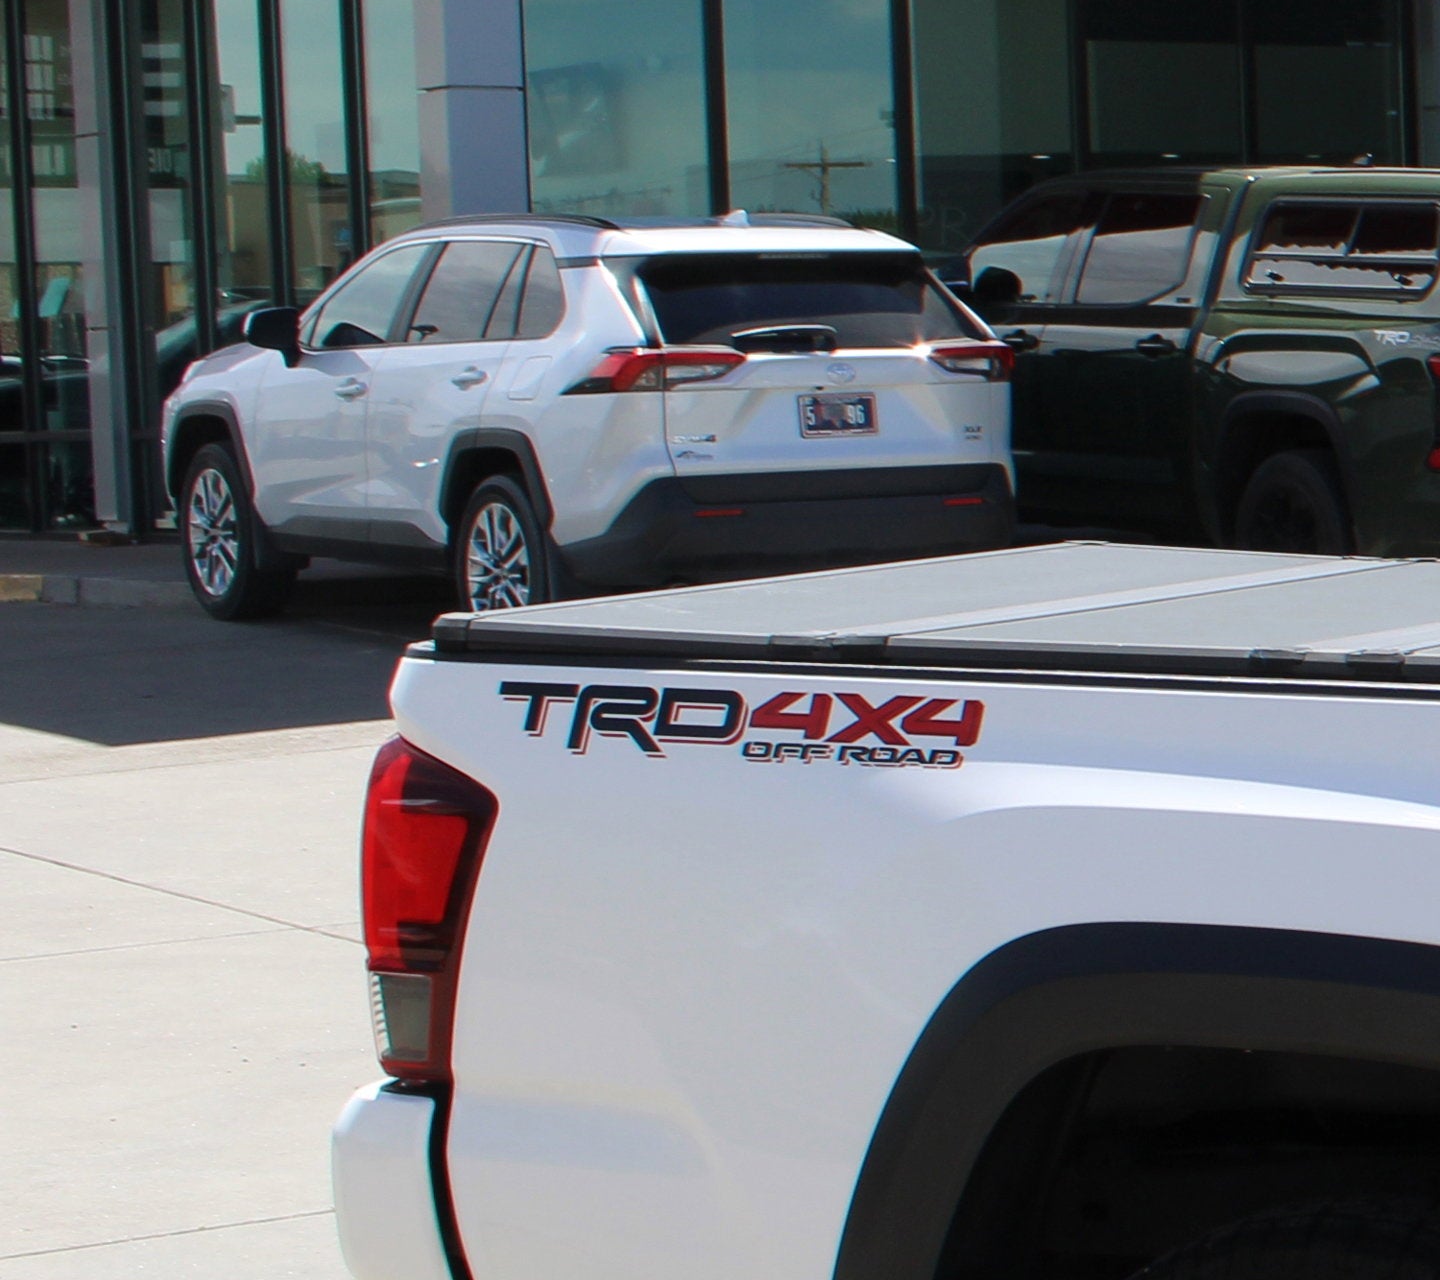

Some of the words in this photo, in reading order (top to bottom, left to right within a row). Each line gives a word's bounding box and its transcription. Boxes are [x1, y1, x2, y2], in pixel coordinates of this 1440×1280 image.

[499, 680, 749, 758] TRD
[742, 741, 832, 764] OFF
[837, 743, 965, 770] ROAD
